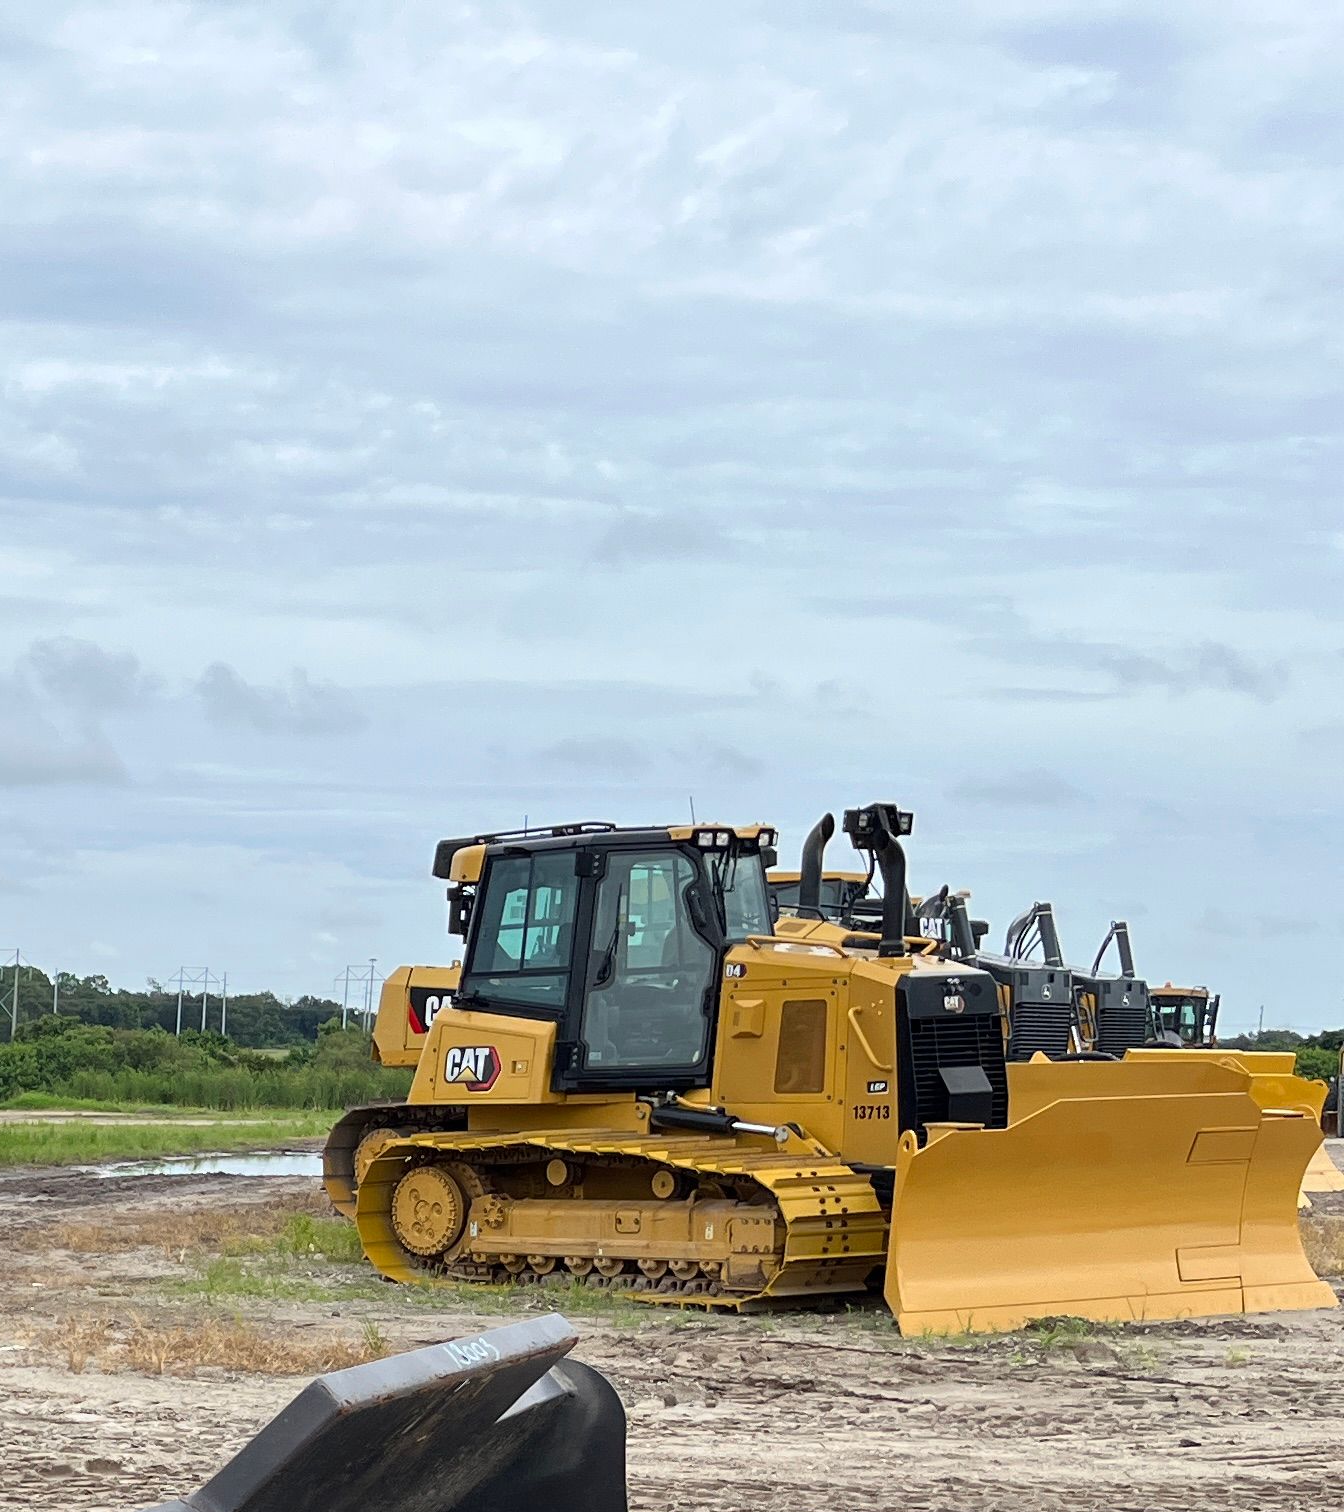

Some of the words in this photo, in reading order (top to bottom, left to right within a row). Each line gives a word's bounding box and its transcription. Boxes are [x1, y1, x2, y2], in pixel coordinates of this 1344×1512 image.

[919, 917, 943, 939] CAT
[445, 1047, 490, 1082] CAT
[853, 1104, 890, 1120] 13713
